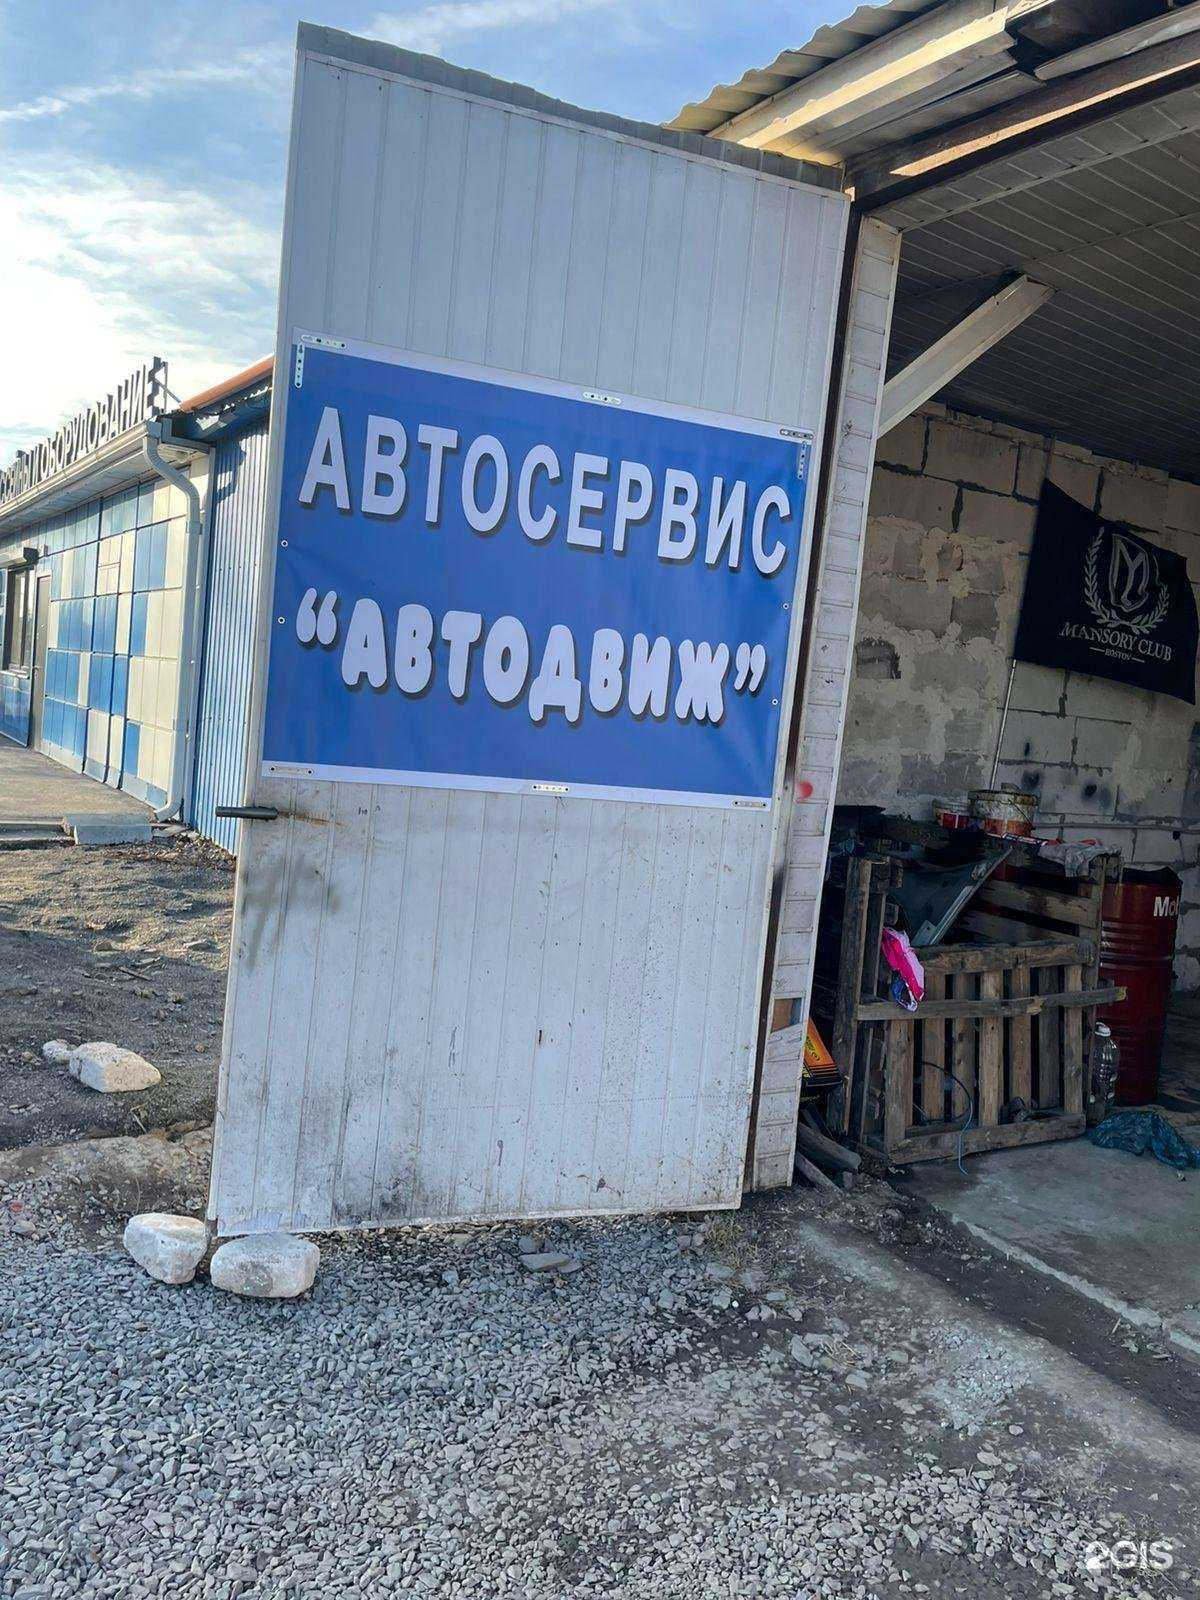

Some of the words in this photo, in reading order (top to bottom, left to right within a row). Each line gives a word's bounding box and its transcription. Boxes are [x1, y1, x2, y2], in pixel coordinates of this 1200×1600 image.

[298, 406, 792, 577] АВТОСЕРВИС
[295, 587, 767, 724] “АВТОДВИЖ”
[1060, 622, 1137, 649] MANSORY
[1138, 638, 1172, 661] CLUB
